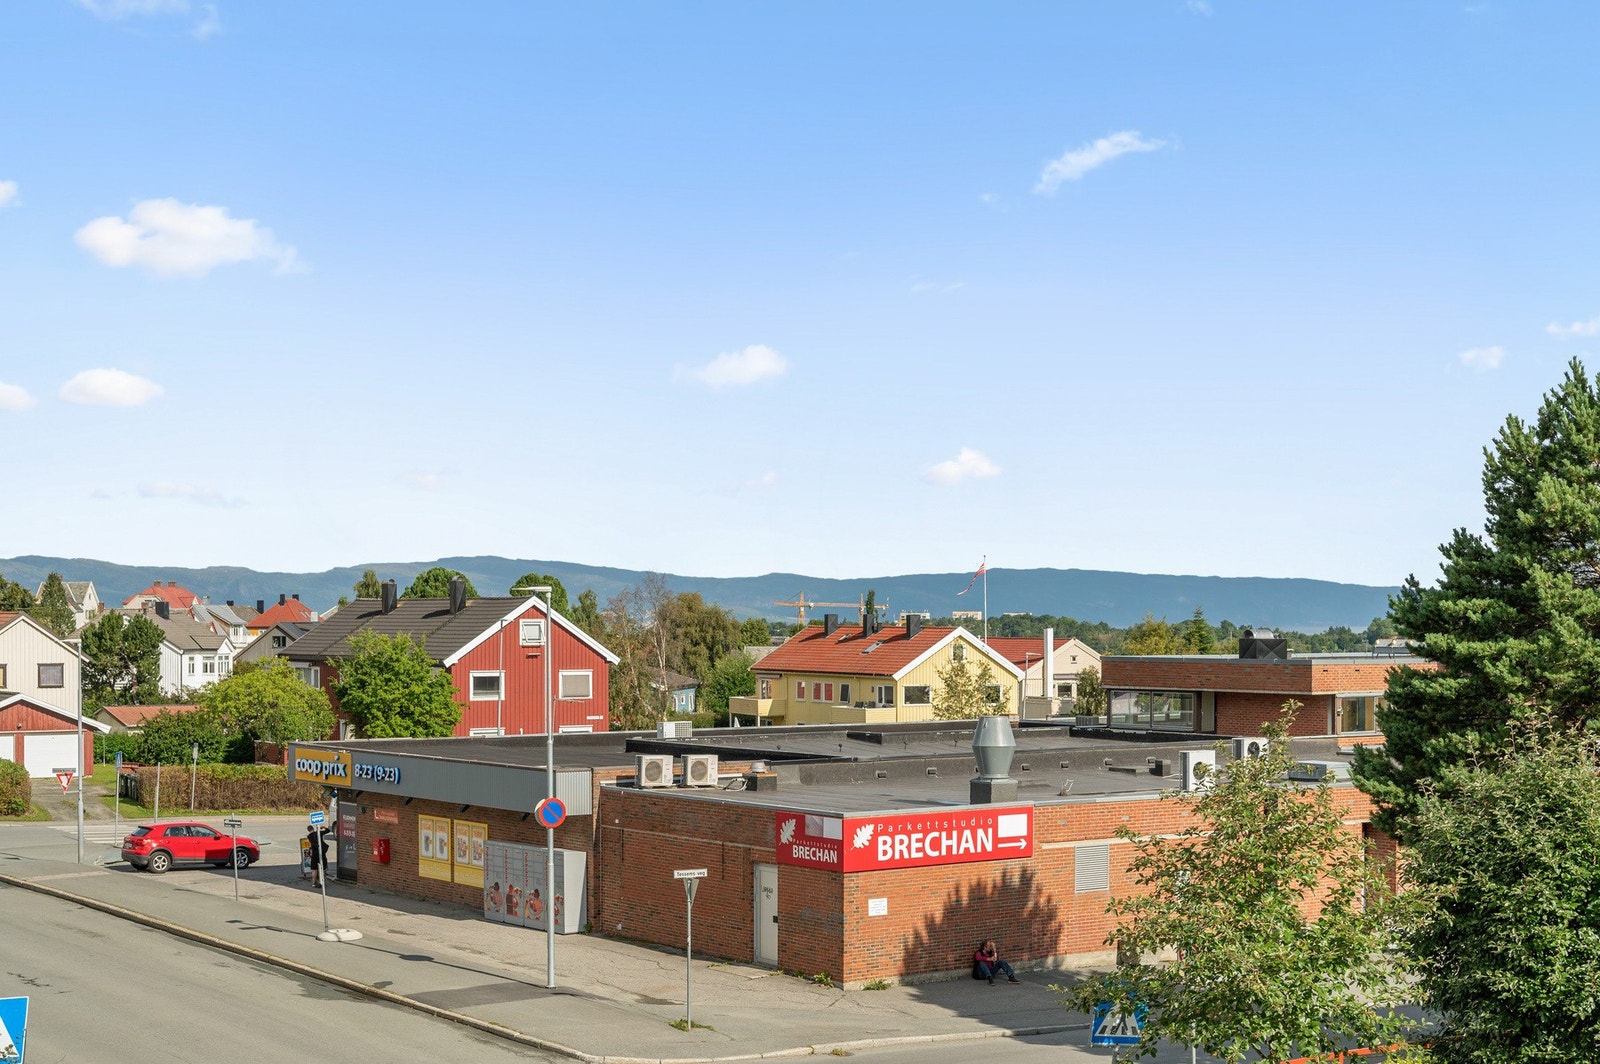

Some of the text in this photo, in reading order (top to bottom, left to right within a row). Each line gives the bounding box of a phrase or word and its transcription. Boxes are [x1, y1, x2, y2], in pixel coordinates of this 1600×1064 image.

[296, 755, 346, 779] coop prix
[354, 763, 400, 784] 8-23 (9-23)
[877, 817, 993, 832] Parkettstudio
[792, 845, 838, 864] BRECHAN
[877, 827, 993, 862] BRECHAN
